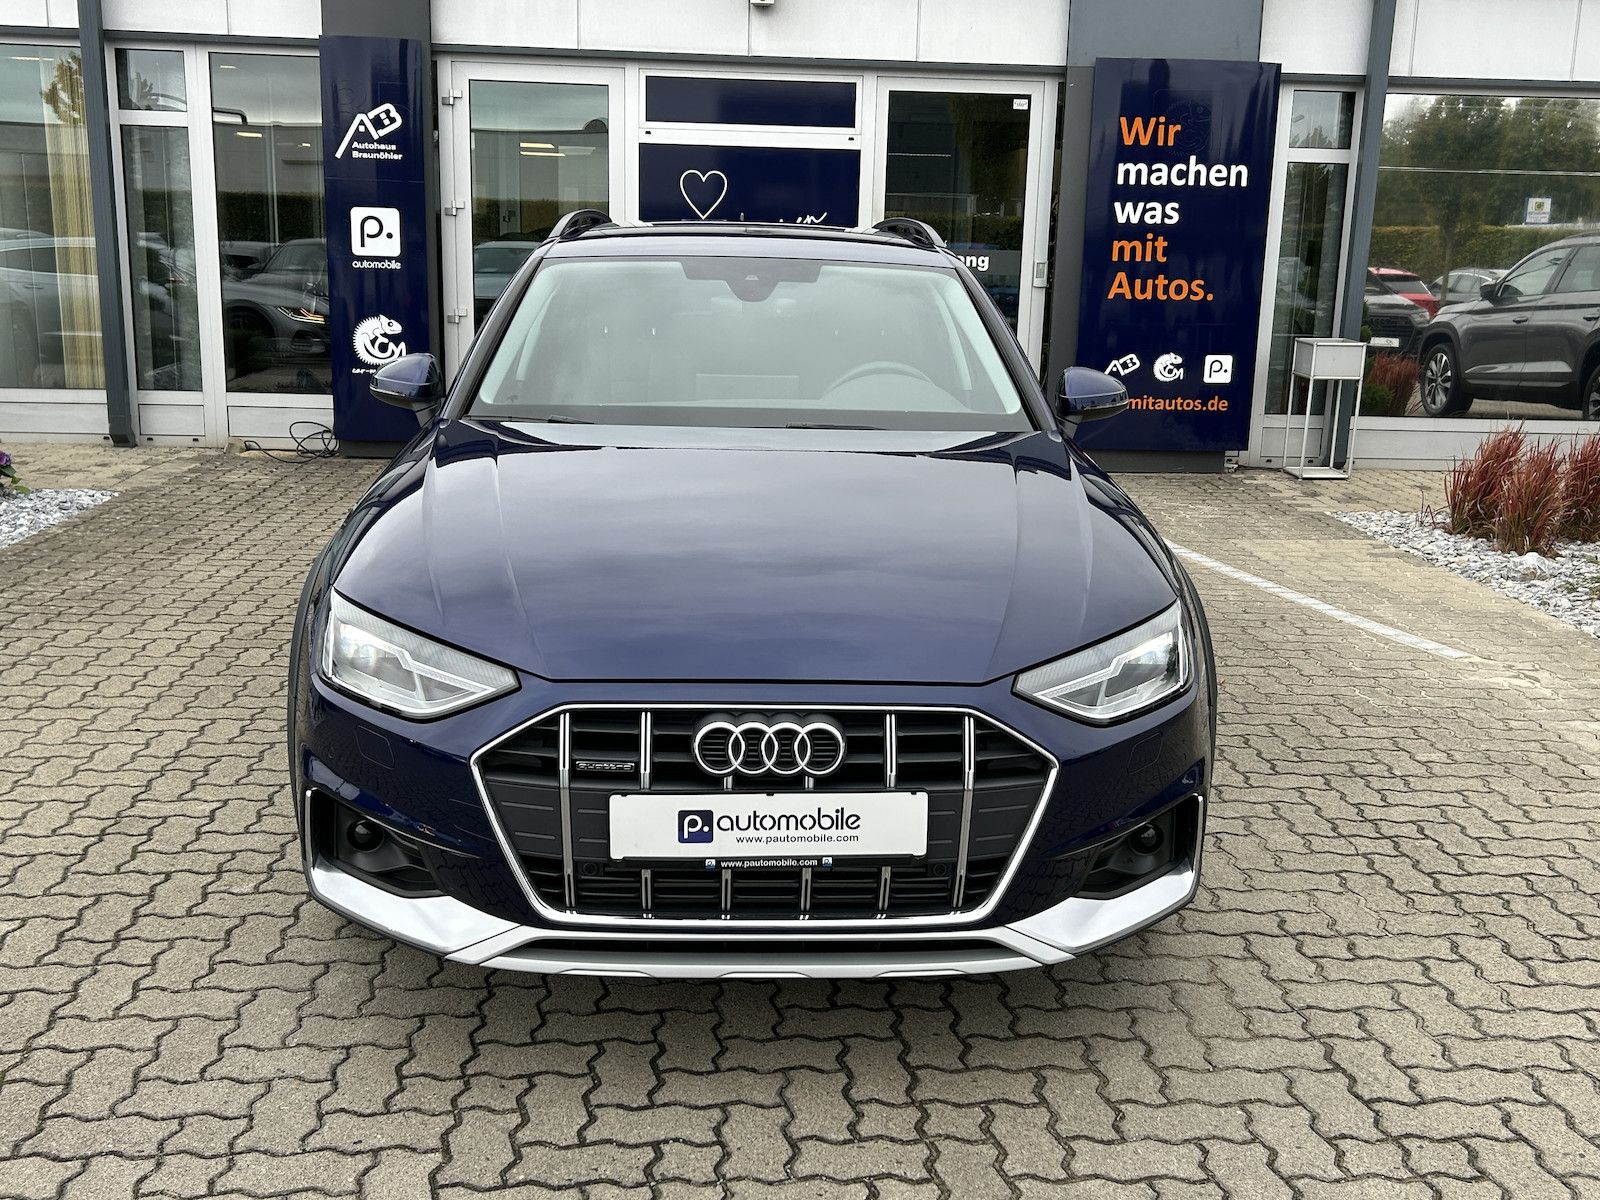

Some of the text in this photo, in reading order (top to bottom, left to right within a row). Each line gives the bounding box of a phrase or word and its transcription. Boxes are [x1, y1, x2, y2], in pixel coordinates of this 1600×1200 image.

[1119, 116, 1182, 146] Wir
[352, 141, 397, 151] Autohaus
[352, 150, 403, 160] Braunöhler
[1116, 155, 1249, 187] machen
[1113, 202, 1180, 224] was
[1111, 233, 1168, 262] mit
[352, 260, 402, 270] automobile
[1107, 271, 1214, 301] Autos.
[716, 806, 862, 832] automobile
[735, 834, 860, 845] www.pautomobile.com
[720, 859, 818, 869] www.pautomobile.com
